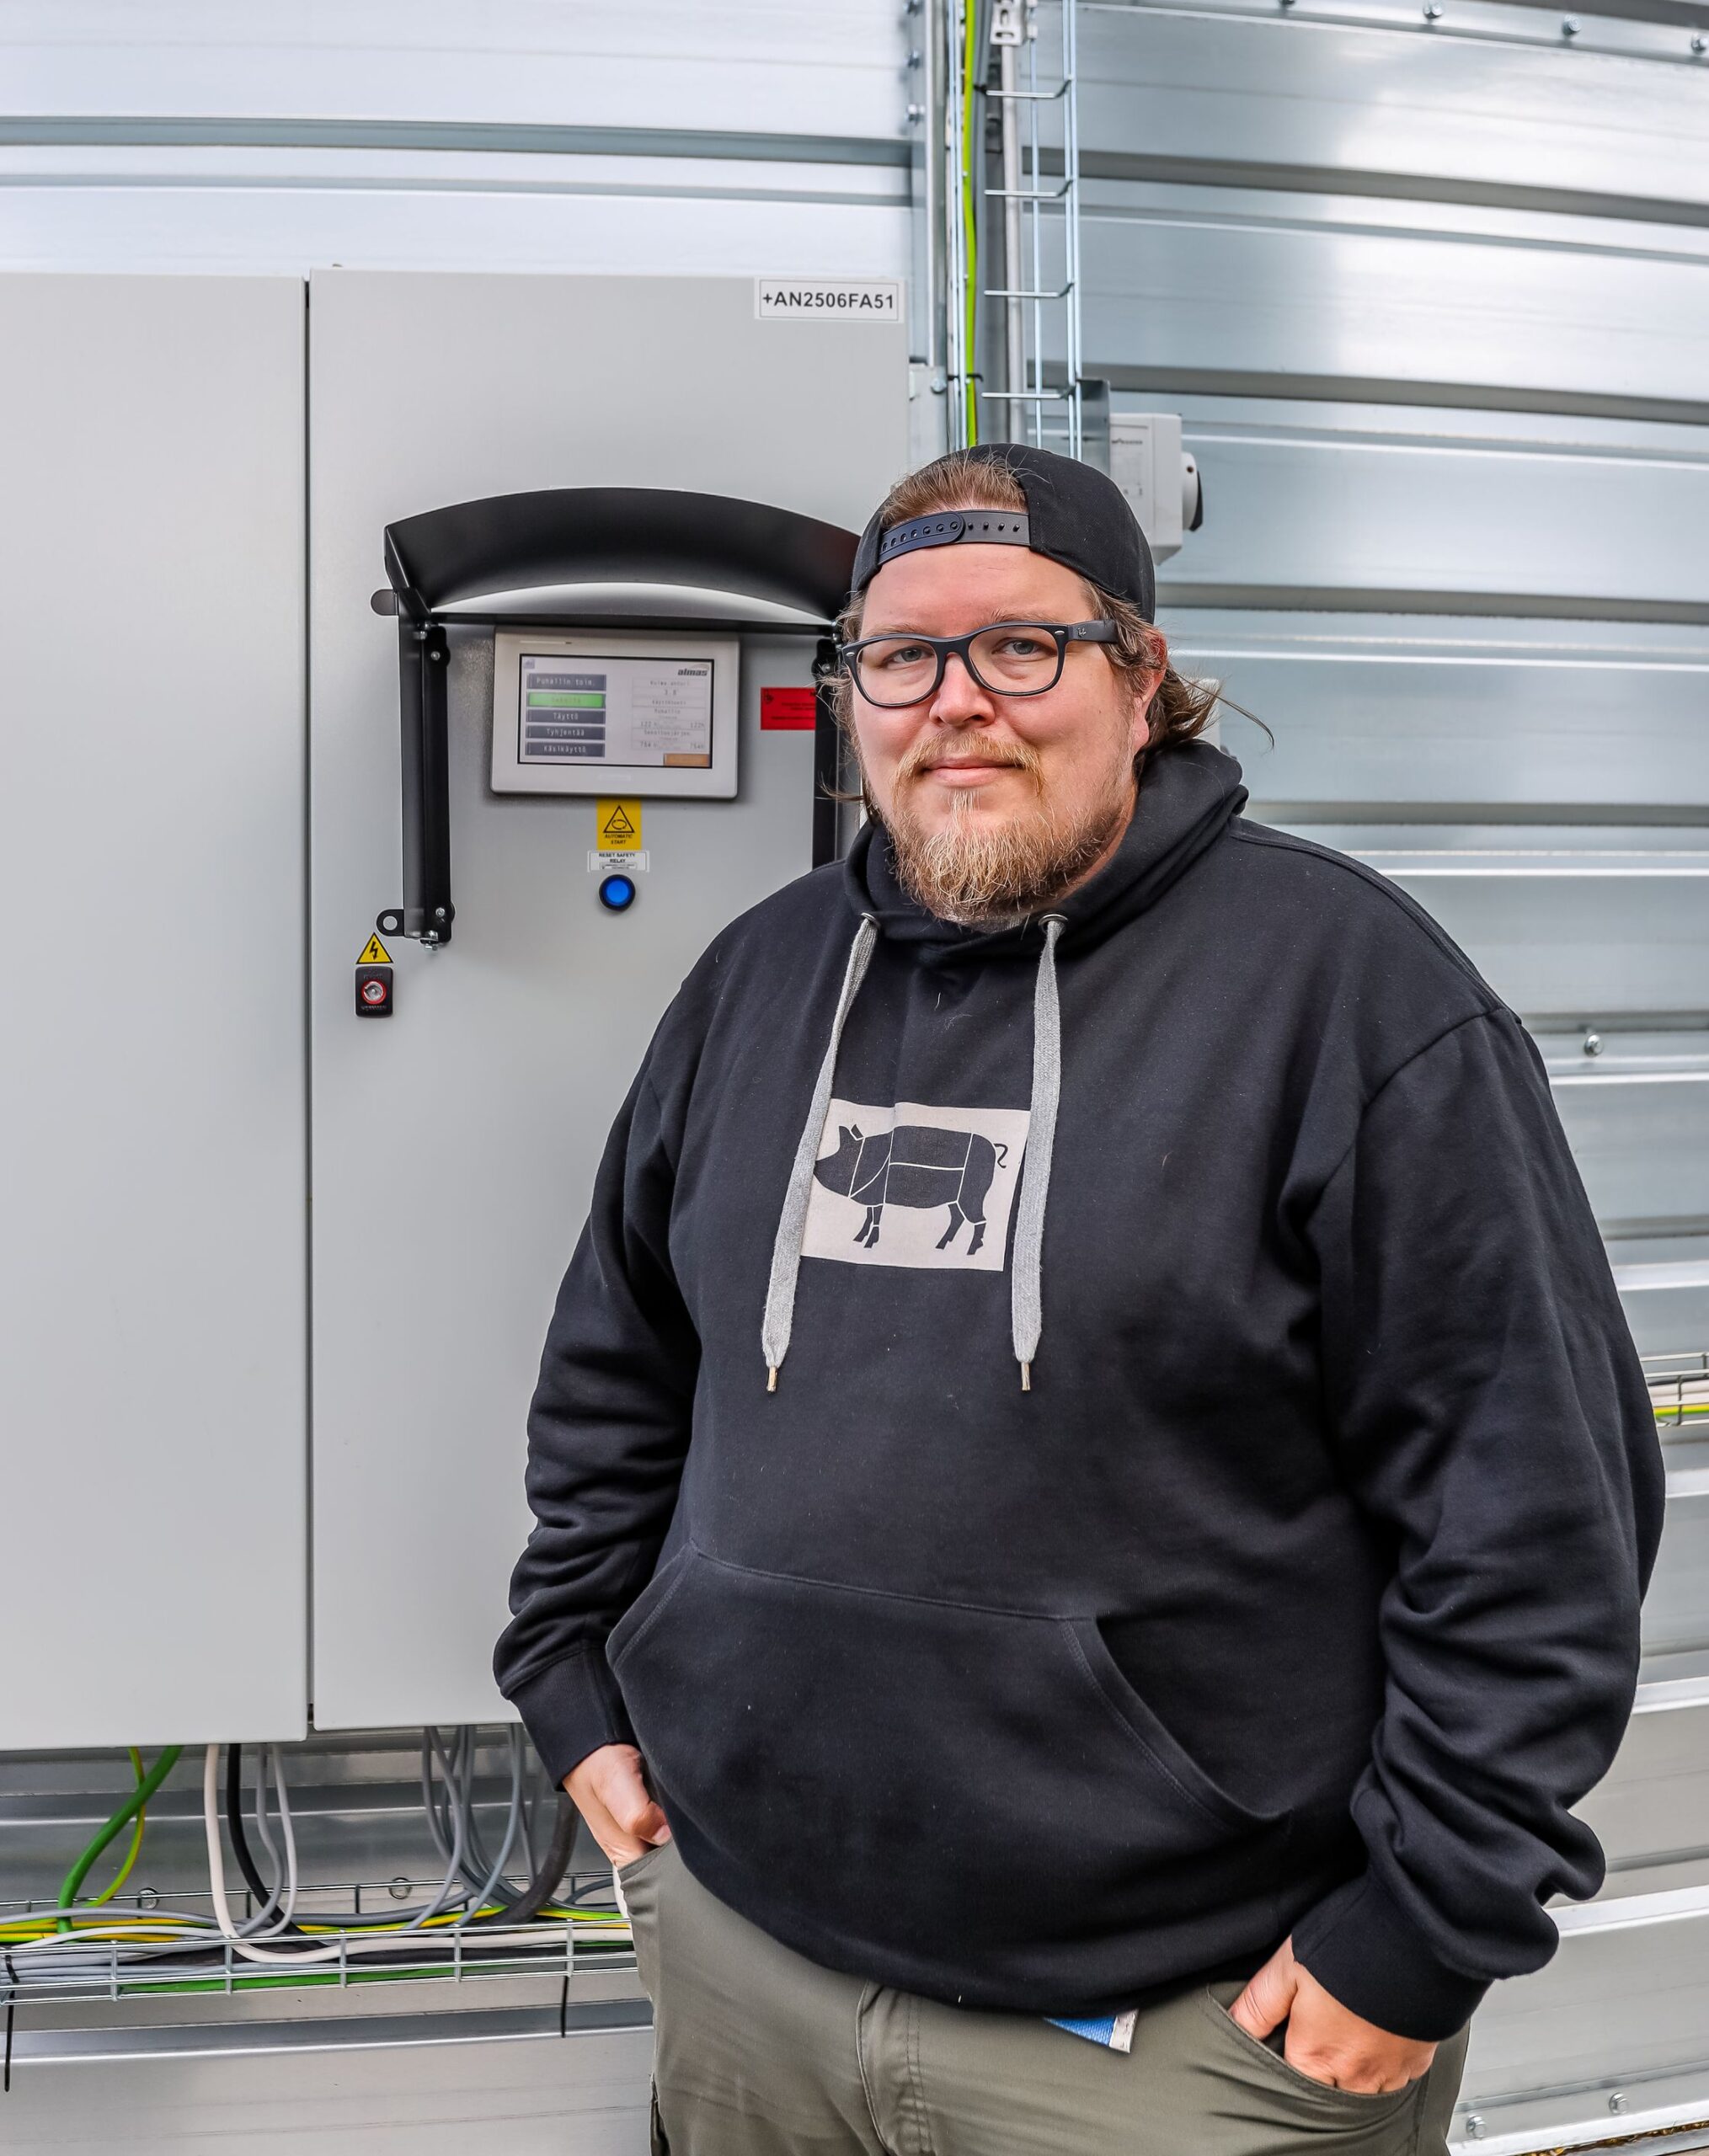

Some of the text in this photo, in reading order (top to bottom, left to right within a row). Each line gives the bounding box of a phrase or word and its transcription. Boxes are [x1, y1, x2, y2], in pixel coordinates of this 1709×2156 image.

[762, 291, 893, 309] +AN2506FA51
[677, 668, 708, 676] almas
[553, 712, 579, 721] Täyttö
